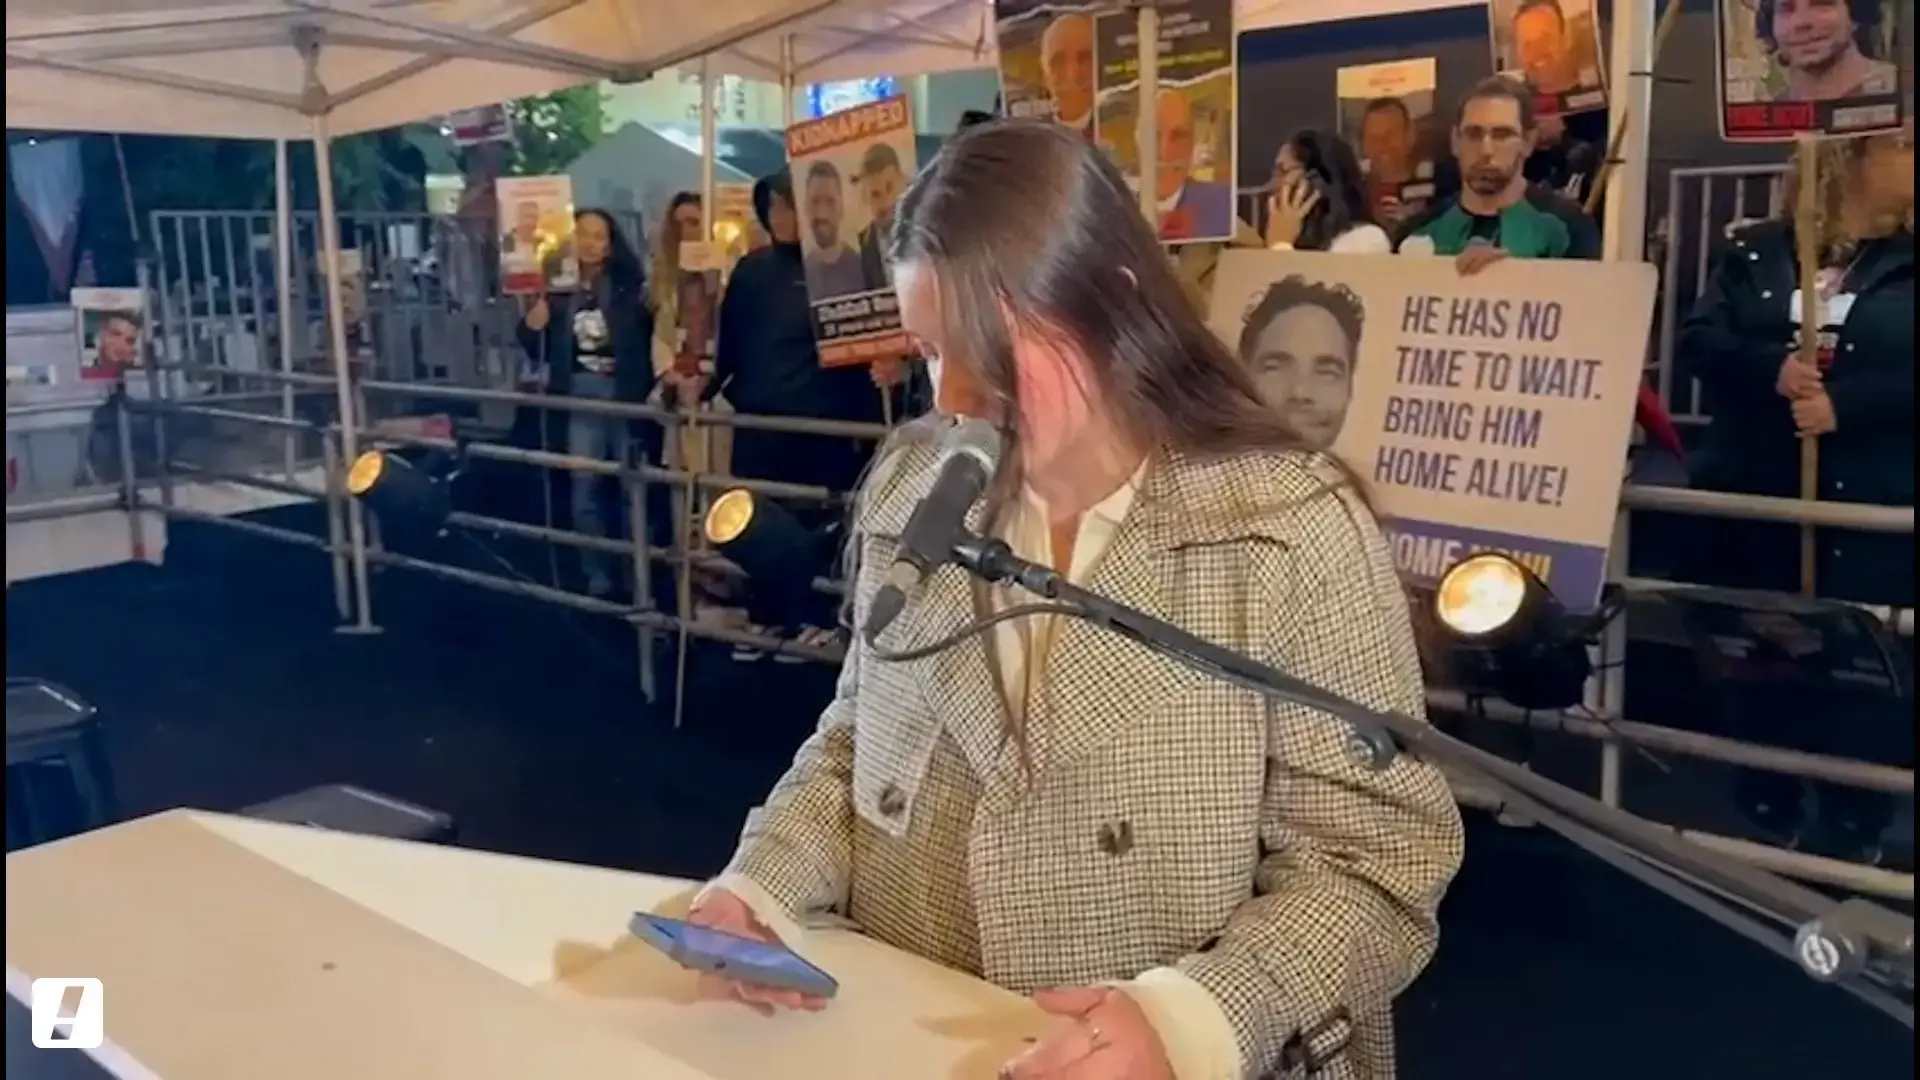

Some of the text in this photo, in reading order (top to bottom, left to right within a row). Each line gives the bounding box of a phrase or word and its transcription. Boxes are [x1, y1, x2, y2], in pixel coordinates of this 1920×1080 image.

[791, 99, 903, 154] KIDNAPPED
[1402, 296, 1562, 341] HE HAS NO
[1396, 346, 1603, 400] TIME TO WAIT.
[1383, 396, 1543, 448] BRING HIM
[1374, 446, 1568, 507] HOME ALIVE!
